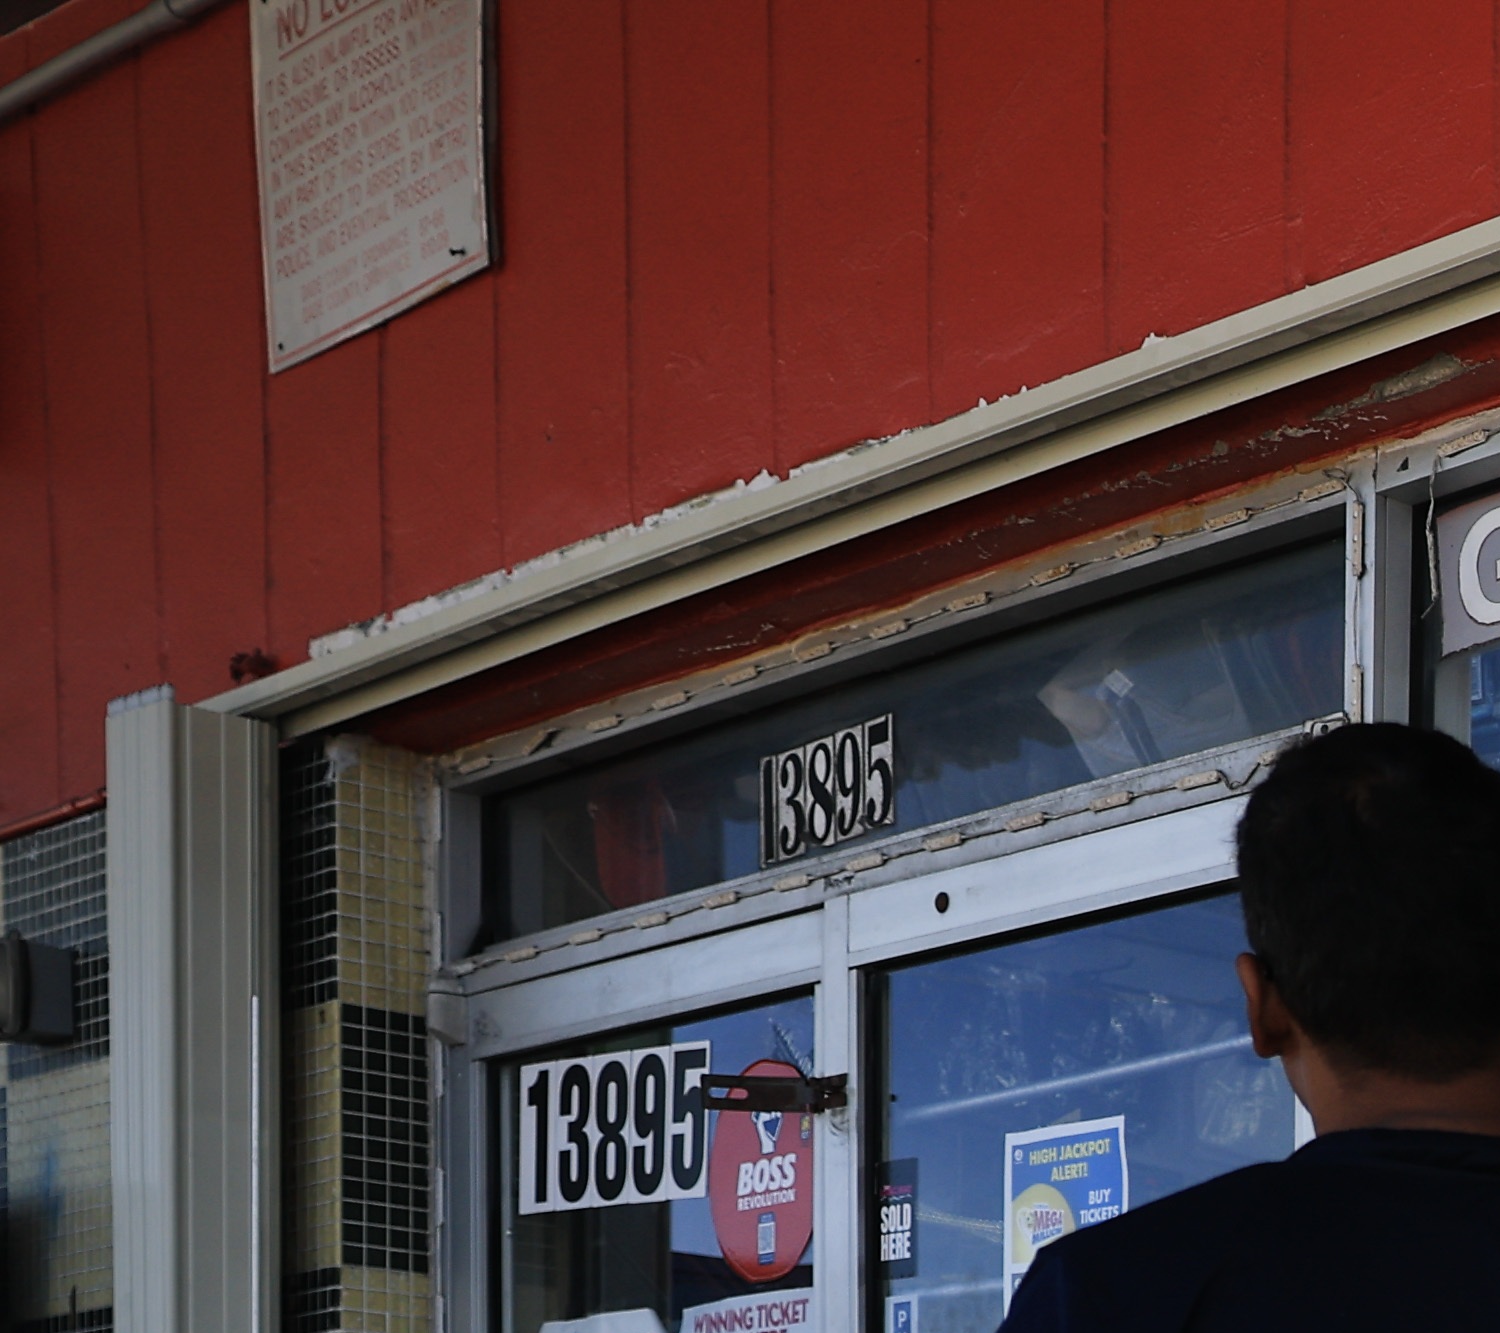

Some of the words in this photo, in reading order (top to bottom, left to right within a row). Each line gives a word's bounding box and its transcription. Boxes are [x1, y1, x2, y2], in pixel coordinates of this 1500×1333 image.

[276, 0, 309, 48] NO
[762, 715, 893, 860] 13895
[528, 1048, 707, 1204] 13895
[1029, 1148, 1058, 1166] HIGH
[1059, 1138, 1111, 1162] JACKPOT
[737, 1153, 797, 1196] BOSS
[1051, 1162, 1088, 1182] ALERT!
[737, 1188, 796, 1211] REVOLUTION
[1088, 1189, 1111, 1205] BUY
[880, 1203, 912, 1233] SOLD
[1033, 1209, 1064, 1232] MEGA
[1080, 1205, 1119, 1224] TICKETS
[880, 1232, 911, 1262] HERE
[755, 1299, 809, 1329] TICKET
